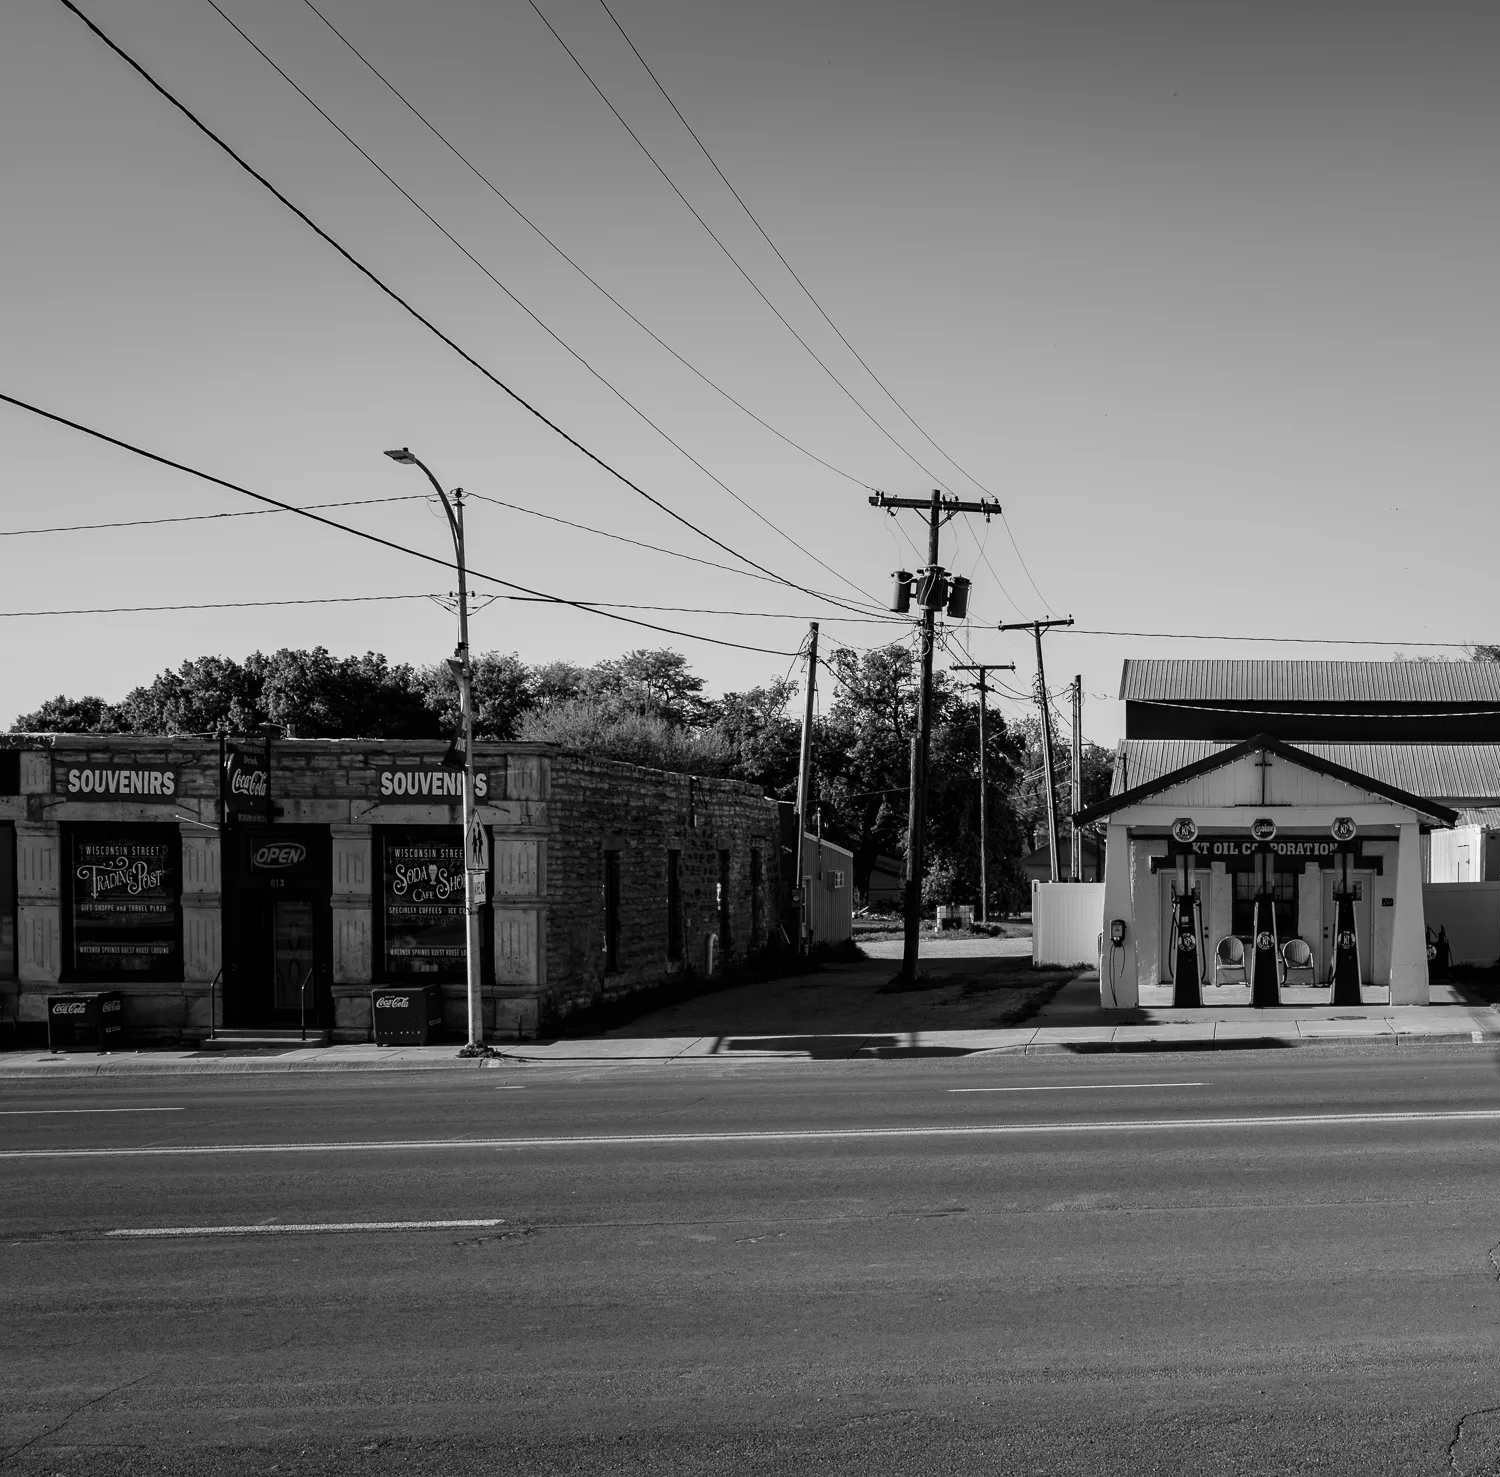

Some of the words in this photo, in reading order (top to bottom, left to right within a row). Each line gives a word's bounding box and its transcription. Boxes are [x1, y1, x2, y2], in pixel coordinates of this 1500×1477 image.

[67, 769, 175, 795] SOUVENIRS
[380, 771, 488, 797] SOUVENIS
[85, 846, 128, 856] WISCONSIN
[131, 846, 160, 856] STREET
[394, 848, 437, 858] WISCONSIN
[440, 848, 465, 859] STREE
[1192, 842, 1210, 855] KT
[1213, 842, 1239, 855] OIL
[256, 846, 301, 864] OPEN
[270, 878, 285, 887] 813
[80, 904, 93, 912] GIFT
[94, 904, 114, 912] SHOPPE
[116, 904, 127, 912] and
[128, 904, 148, 912] TRAVEL
[149, 904, 167, 912] PLAZA
[388, 906, 417, 914] SPECIALTY
[418, 906, 442, 914] COFFEES
[101, 946, 120, 954] SPRINGS
[121, 946, 135, 954] GUEST
[136, 946, 150, 954] HOUSE
[151, 946, 169, 954] LODGING
